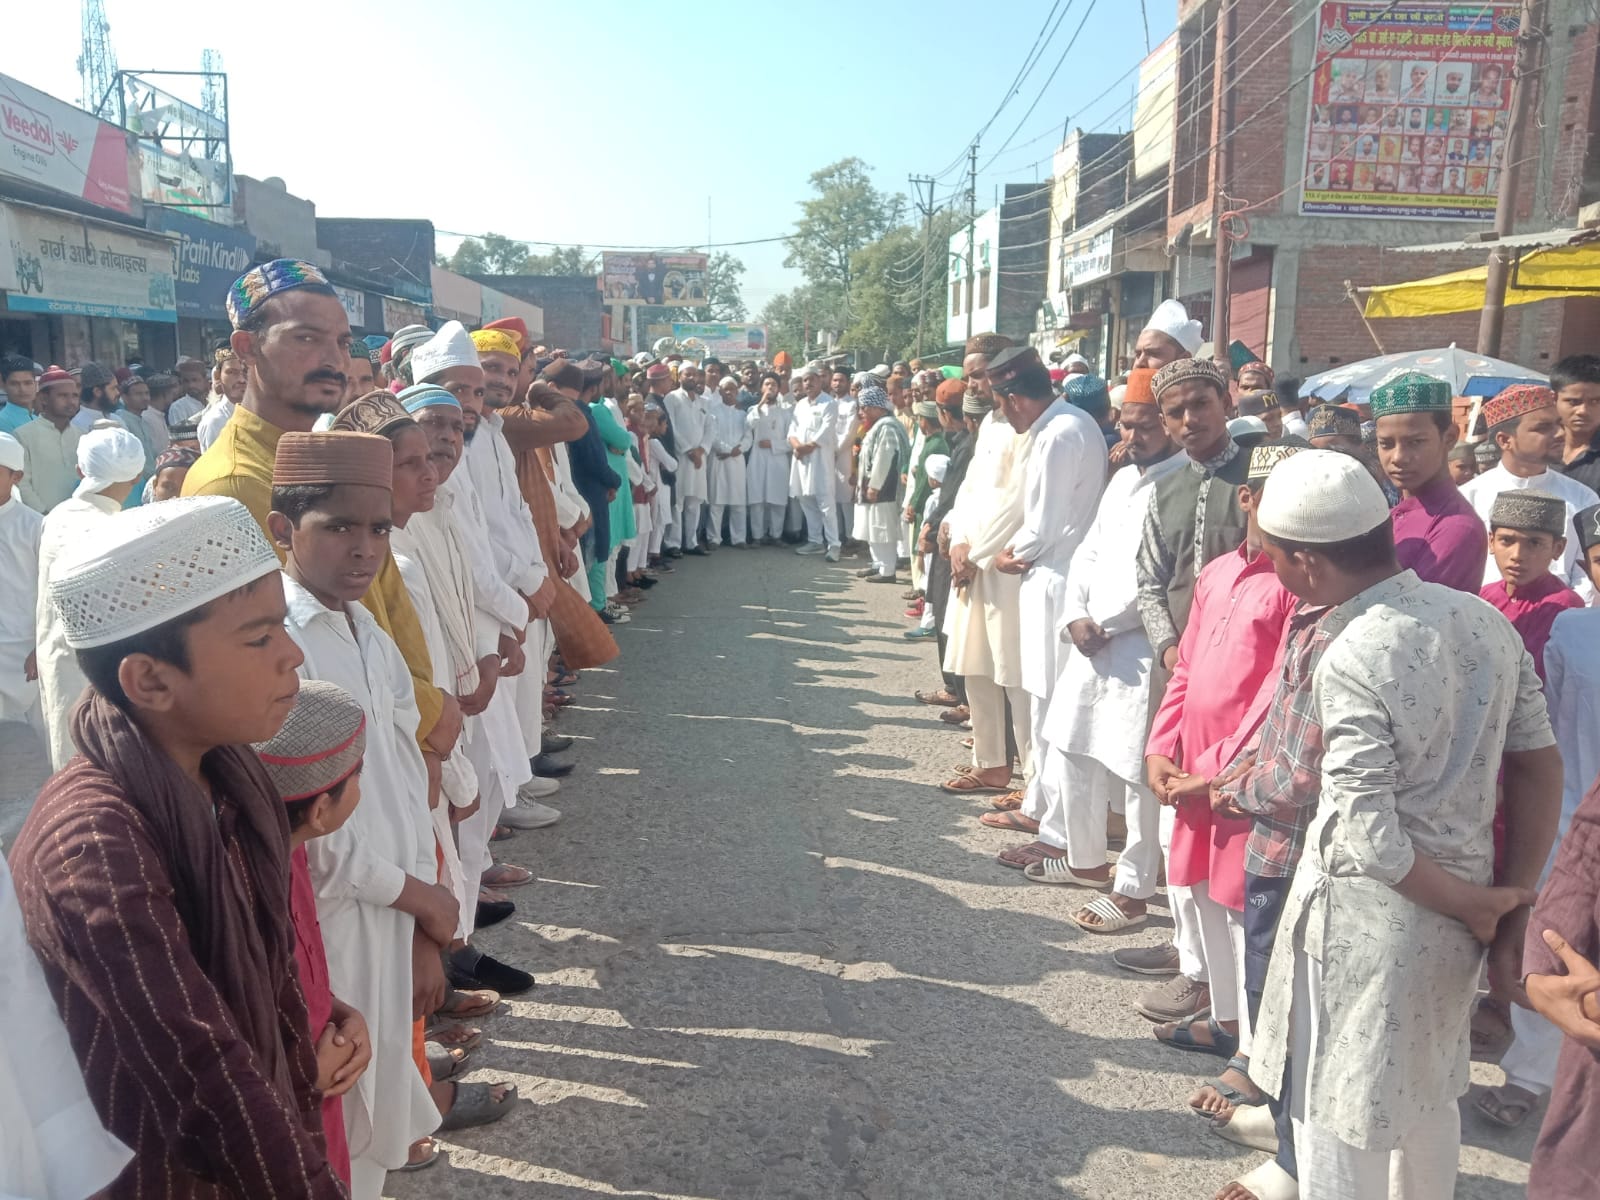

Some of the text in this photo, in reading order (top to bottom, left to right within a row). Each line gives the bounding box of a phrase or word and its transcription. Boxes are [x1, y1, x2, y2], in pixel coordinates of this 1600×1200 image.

[2, 104, 52, 146] Veedol
[13, 144, 34, 162] Engine
[38, 236, 66, 260] गर्ग
[181, 263, 200, 284] Labs
